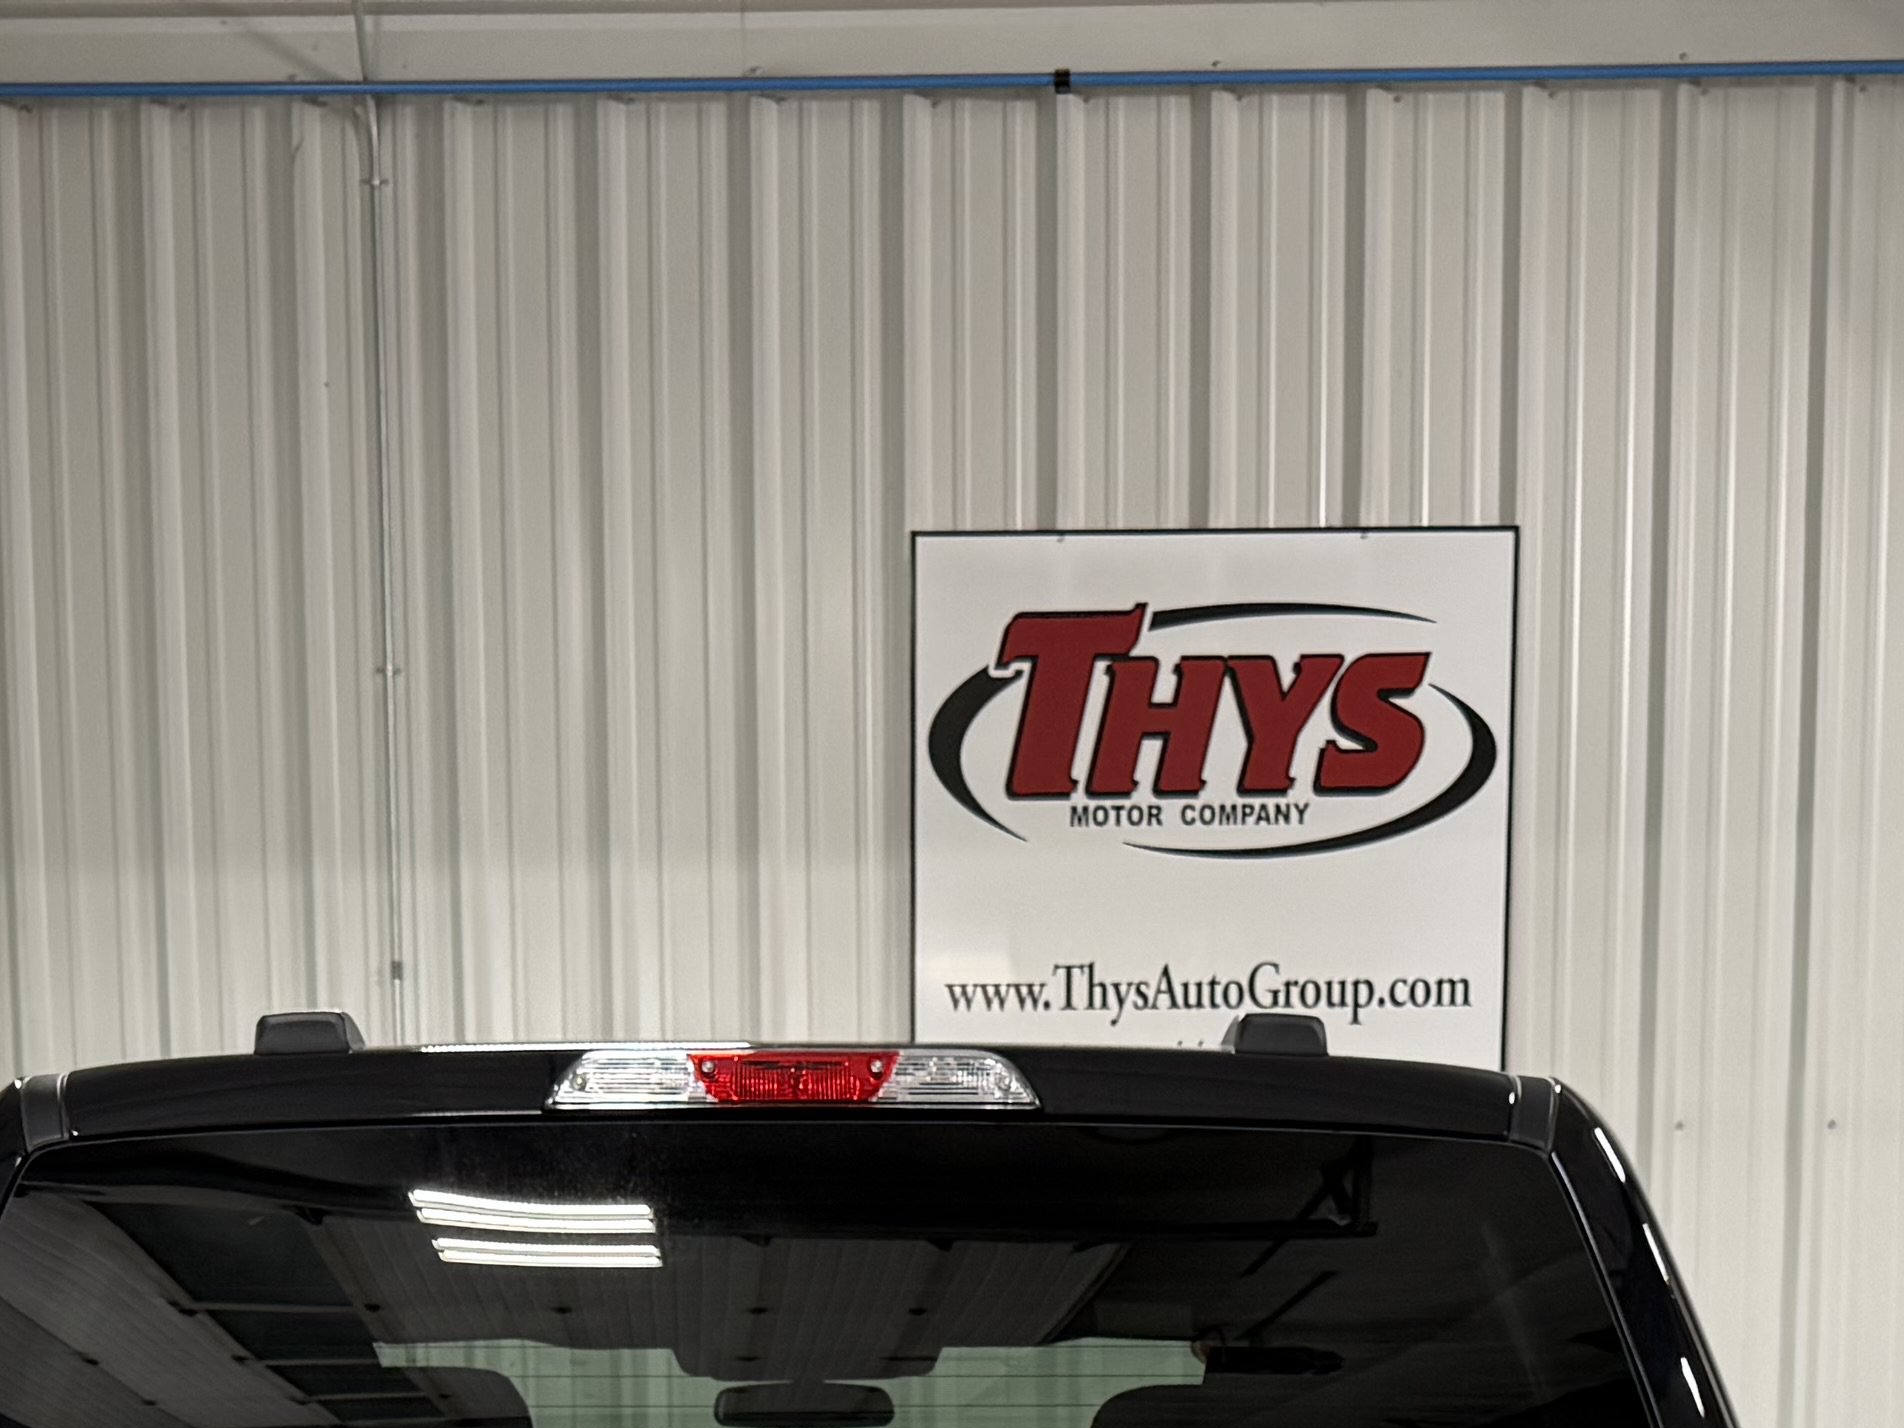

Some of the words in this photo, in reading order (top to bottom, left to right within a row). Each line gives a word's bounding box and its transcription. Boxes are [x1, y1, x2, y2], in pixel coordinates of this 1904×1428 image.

[996, 603, 1432, 800] THYS
[1069, 804, 1163, 827] MOTOR
[1180, 802, 1309, 826] COMPANY
[945, 962, 1472, 1026] www.ThysAutoGroup.com
